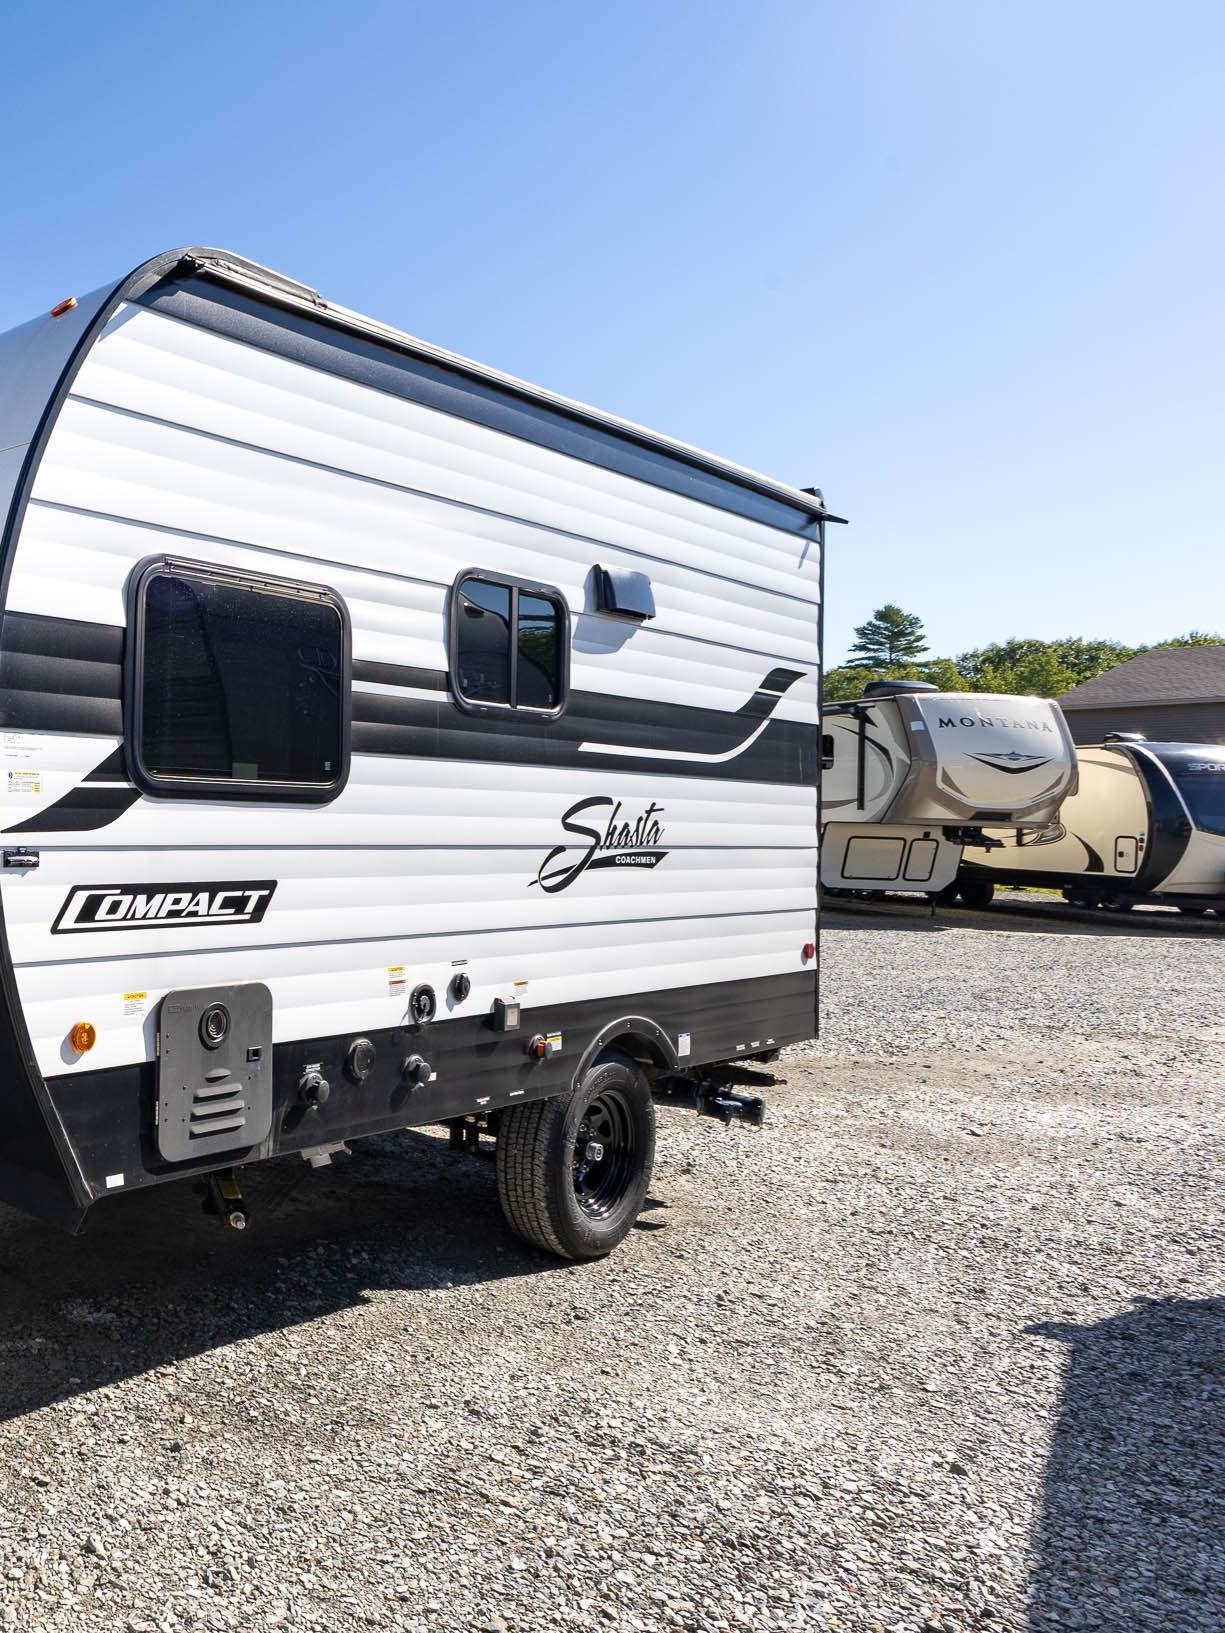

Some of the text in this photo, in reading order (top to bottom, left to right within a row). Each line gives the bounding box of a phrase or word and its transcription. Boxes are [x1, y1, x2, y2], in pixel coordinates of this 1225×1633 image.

[938, 717, 1053, 732] MONTANA
[538, 796, 665, 893] Shasta
[615, 855, 656, 864] COACHMEN
[57, 889, 270, 930] COMPACT
